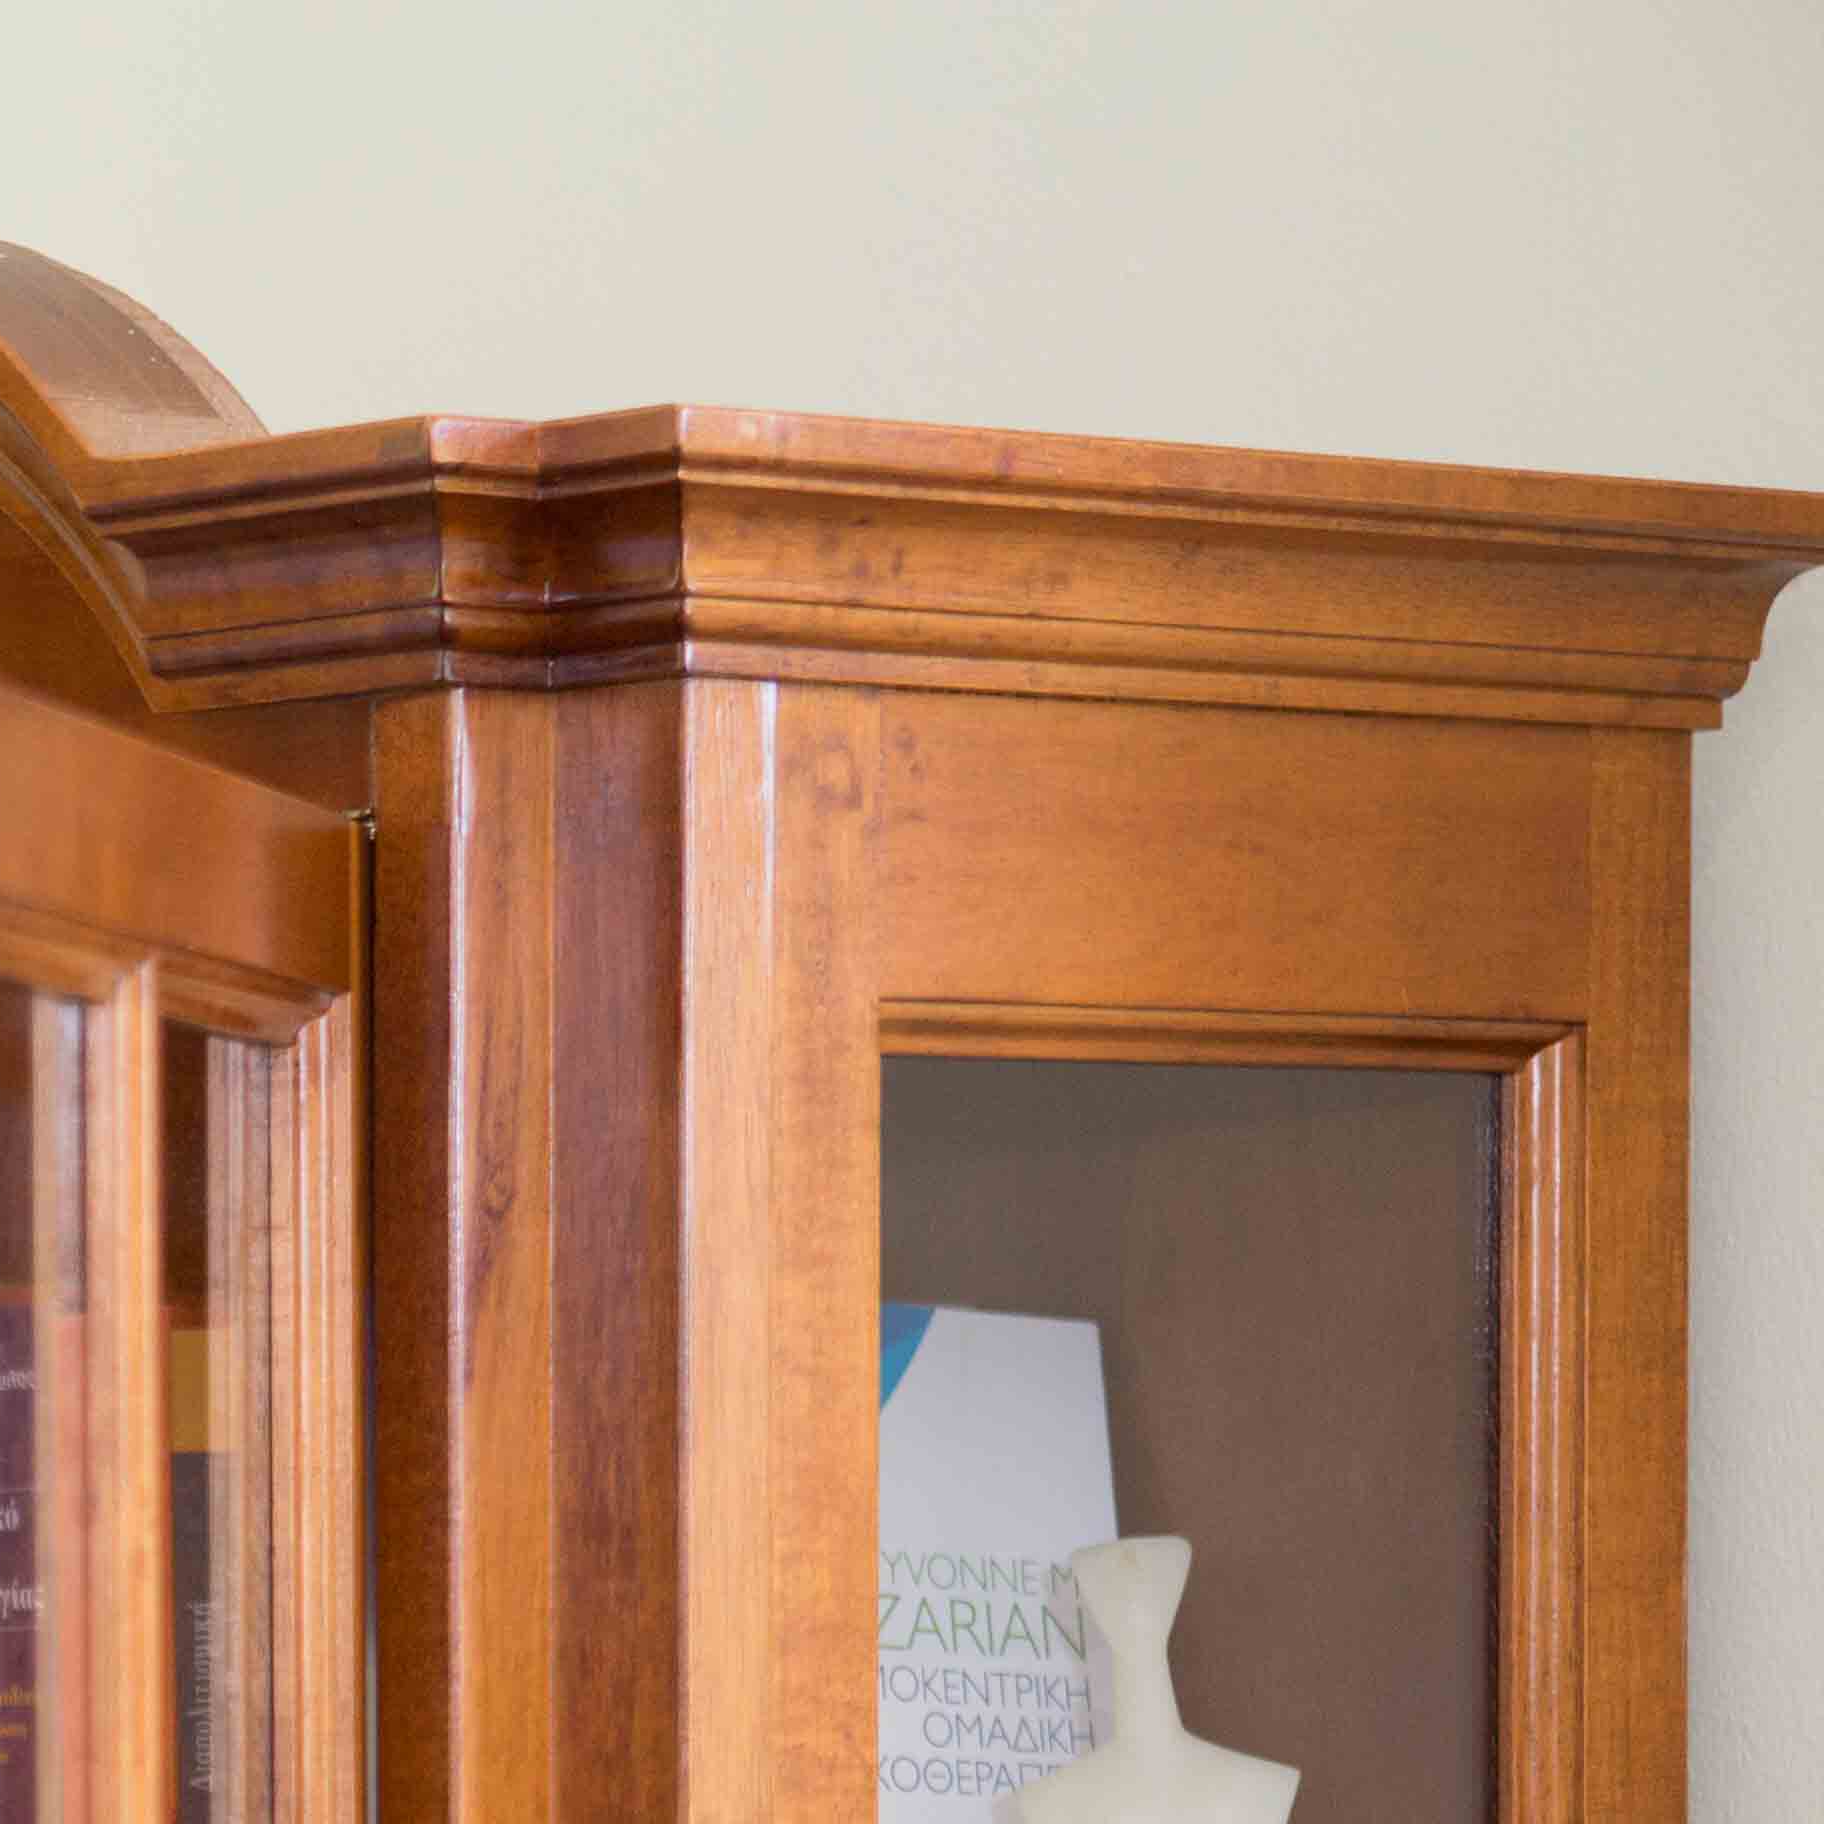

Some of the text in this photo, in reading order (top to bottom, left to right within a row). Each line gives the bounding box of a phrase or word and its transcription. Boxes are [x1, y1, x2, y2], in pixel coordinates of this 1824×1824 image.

[882, 1551, 1042, 1596] YVONNE
[878, 1593, 1087, 1661] ZARIAN
[879, 1664, 1092, 1712] ΟΚΕΝΤΡΙΚΗ
[922, 1711, 1096, 1752] ΟΜΑΔΙΚΗ
